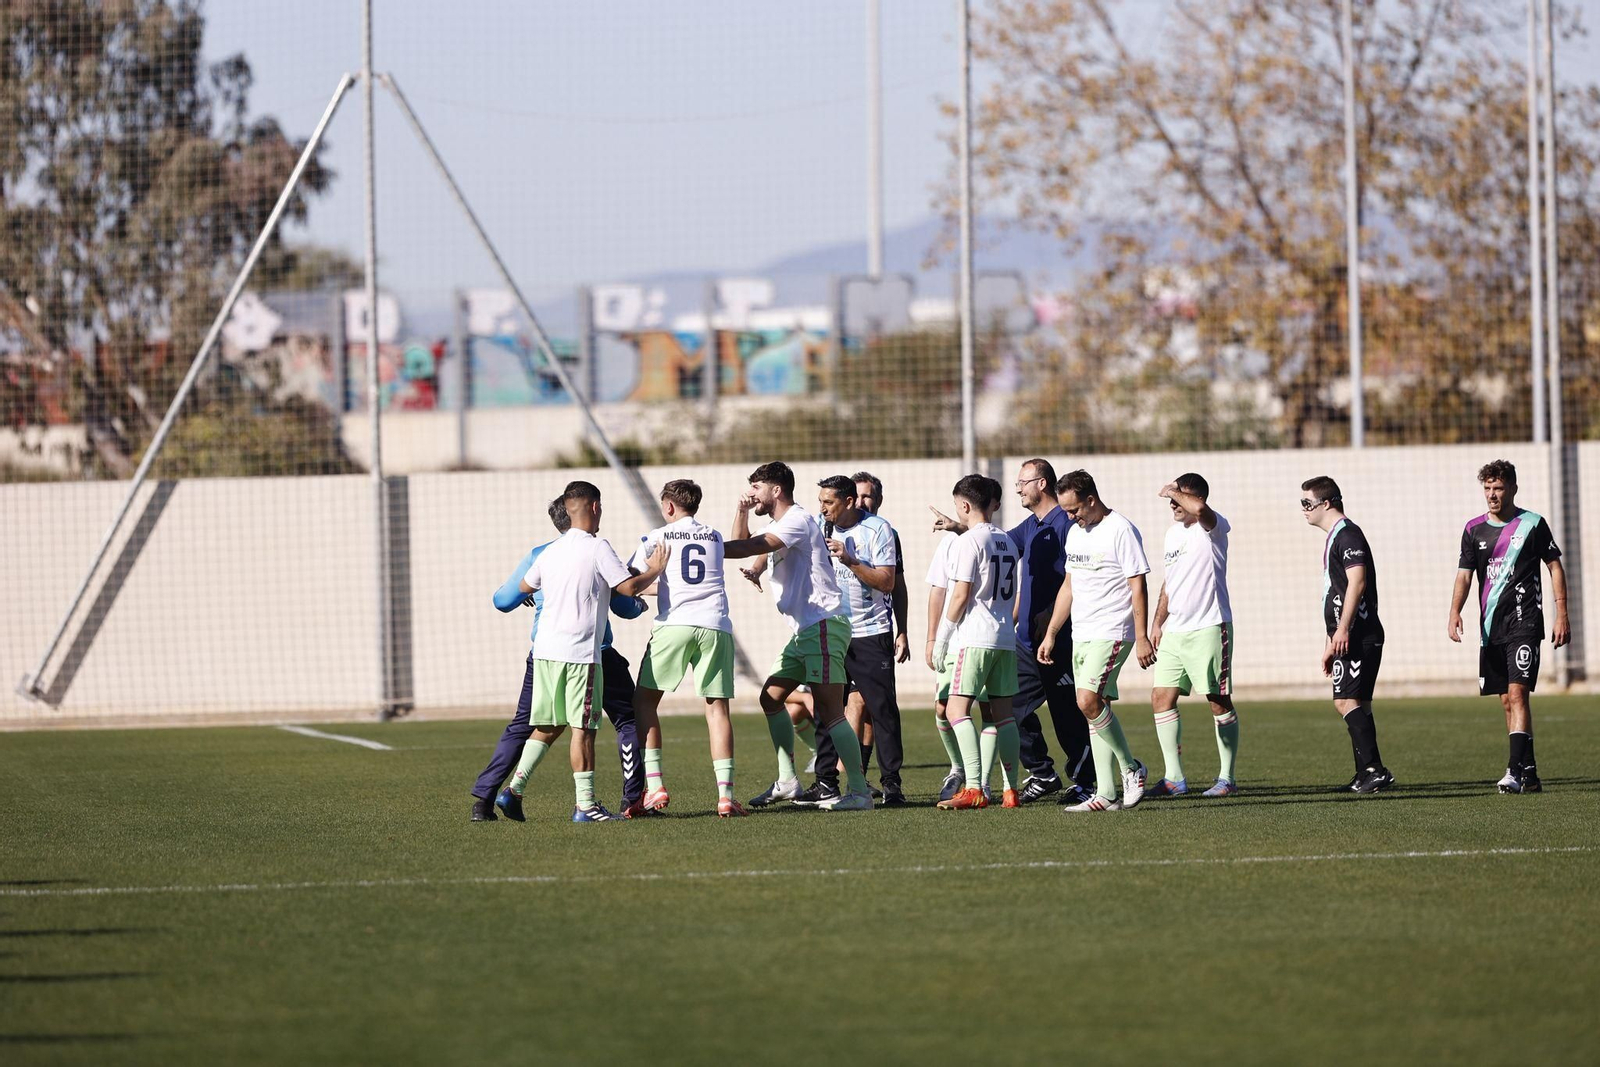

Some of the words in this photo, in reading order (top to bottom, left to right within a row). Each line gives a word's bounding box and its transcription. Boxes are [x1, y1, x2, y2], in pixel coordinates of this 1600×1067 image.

[664, 531, 691, 541] NACHO
[681, 543, 706, 585] 6
[990, 554, 1016, 601] 13
